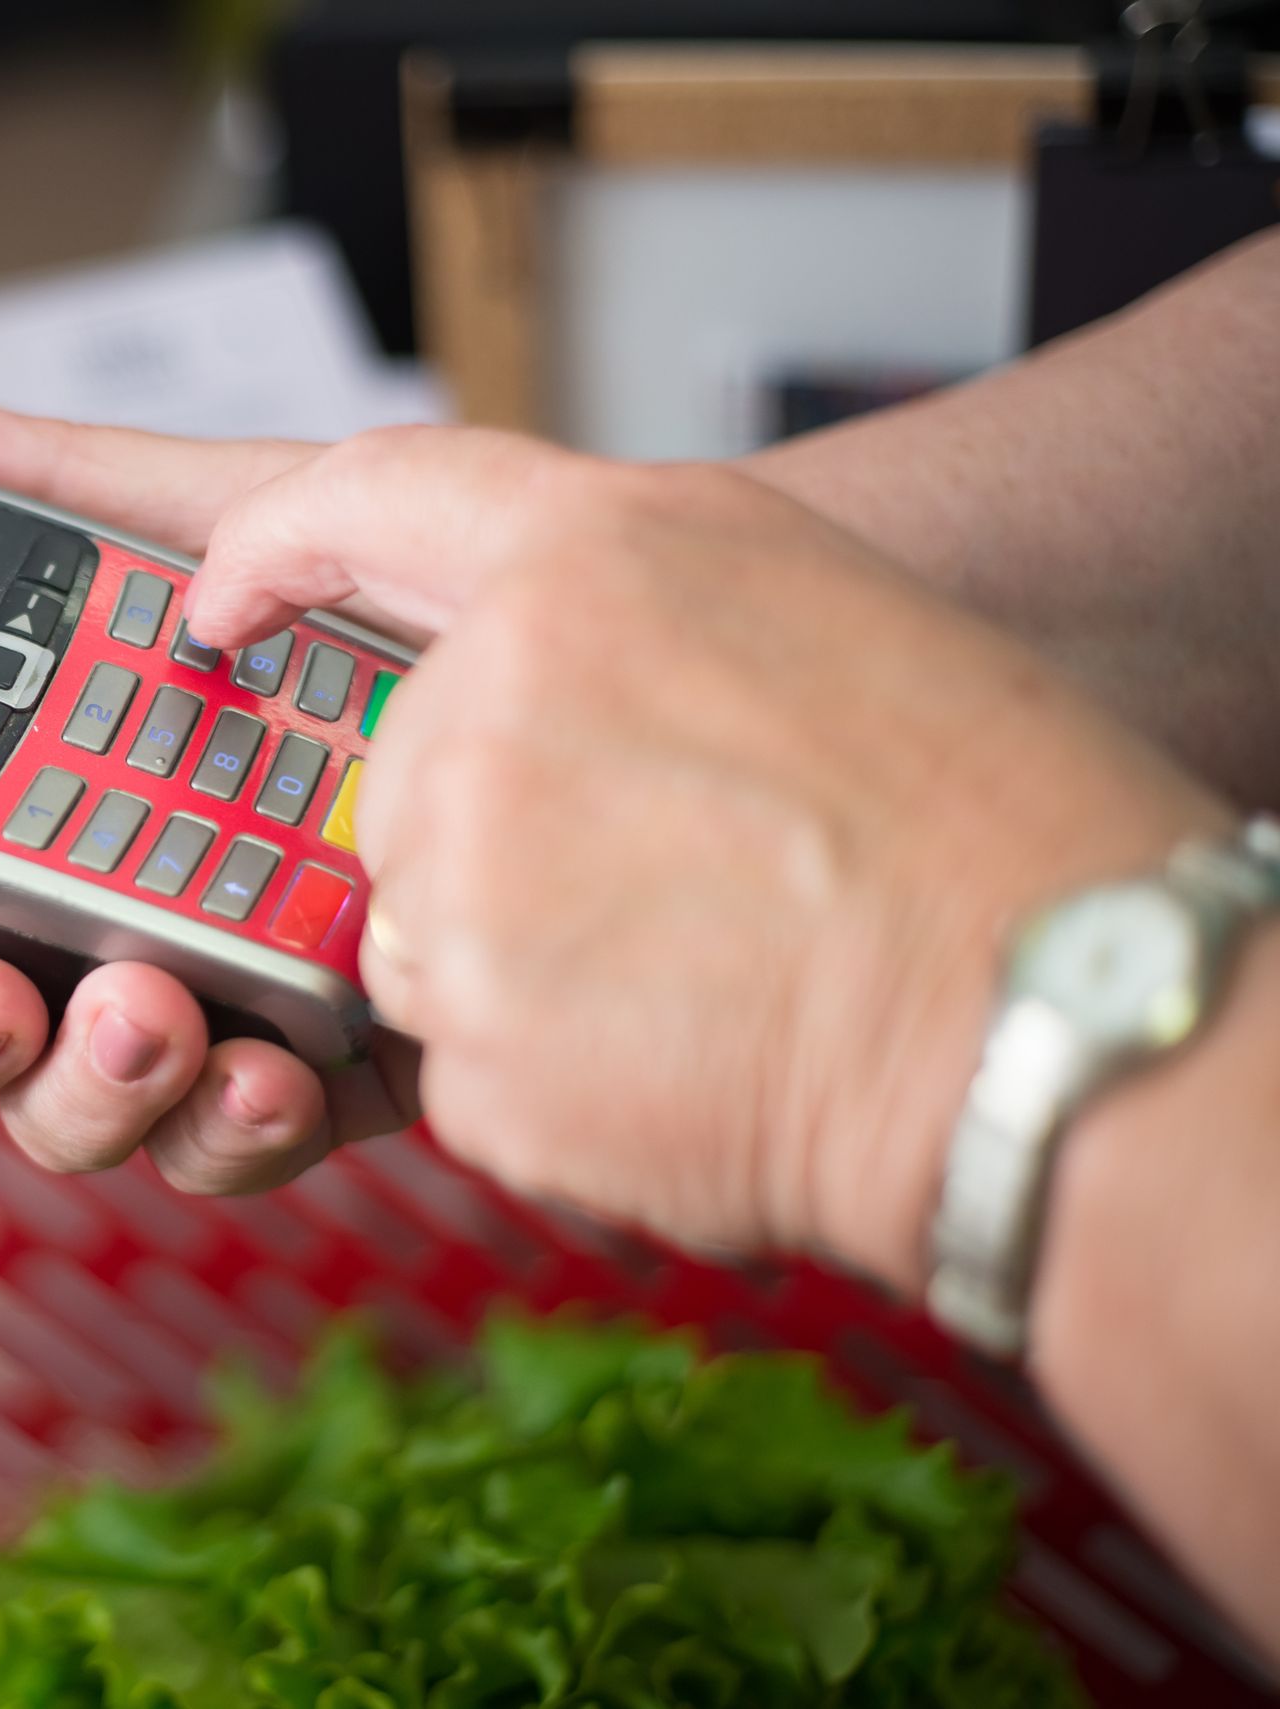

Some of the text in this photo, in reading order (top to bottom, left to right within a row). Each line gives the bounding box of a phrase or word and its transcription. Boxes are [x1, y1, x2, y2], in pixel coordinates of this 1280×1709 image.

[128, 606, 153, 624] 3
[250, 656, 276, 673] 9
[84, 703, 112, 724] 2
[148, 726, 175, 746] 5
[213, 752, 240, 772] 8
[277, 775, 304, 795] 0
[28, 805, 53, 818] 1
[92, 831, 118, 849] 4
[157, 854, 183, 875] 7
